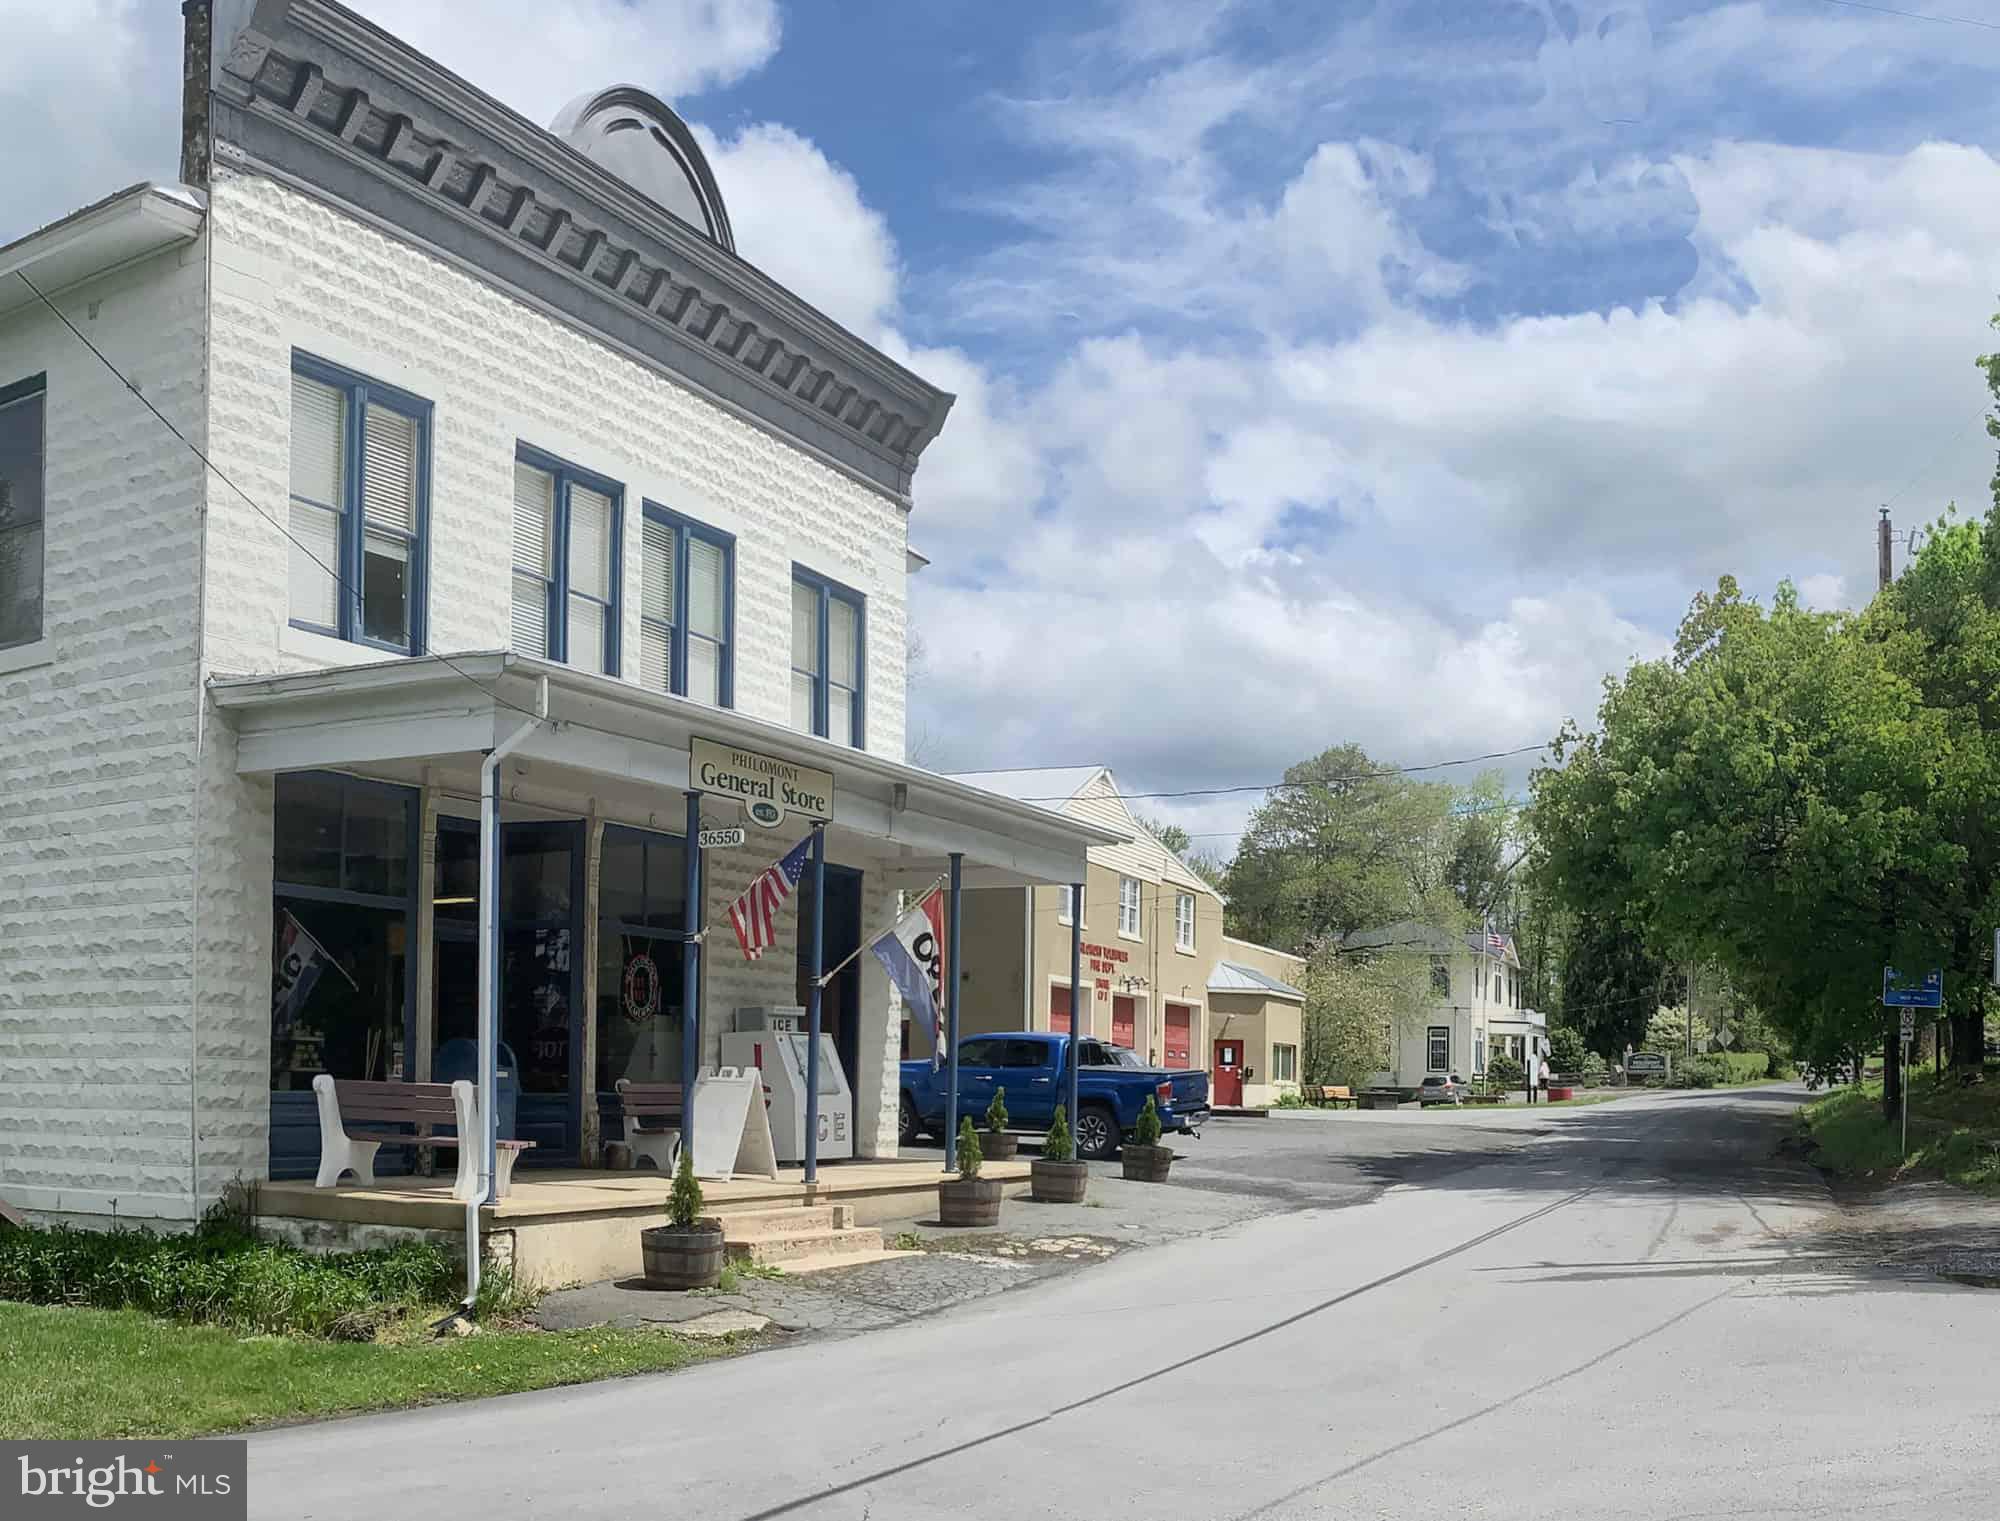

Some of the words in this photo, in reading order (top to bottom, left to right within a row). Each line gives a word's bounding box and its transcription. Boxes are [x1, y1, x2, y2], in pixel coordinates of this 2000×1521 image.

[731, 752, 799, 782] PHILOMONT
[700, 763, 774, 800] General
[781, 782, 825, 812] Store
[700, 830, 741, 846] 36550
[773, 1019, 792, 1032] ICE
[806, 1111, 846, 1142] CE
